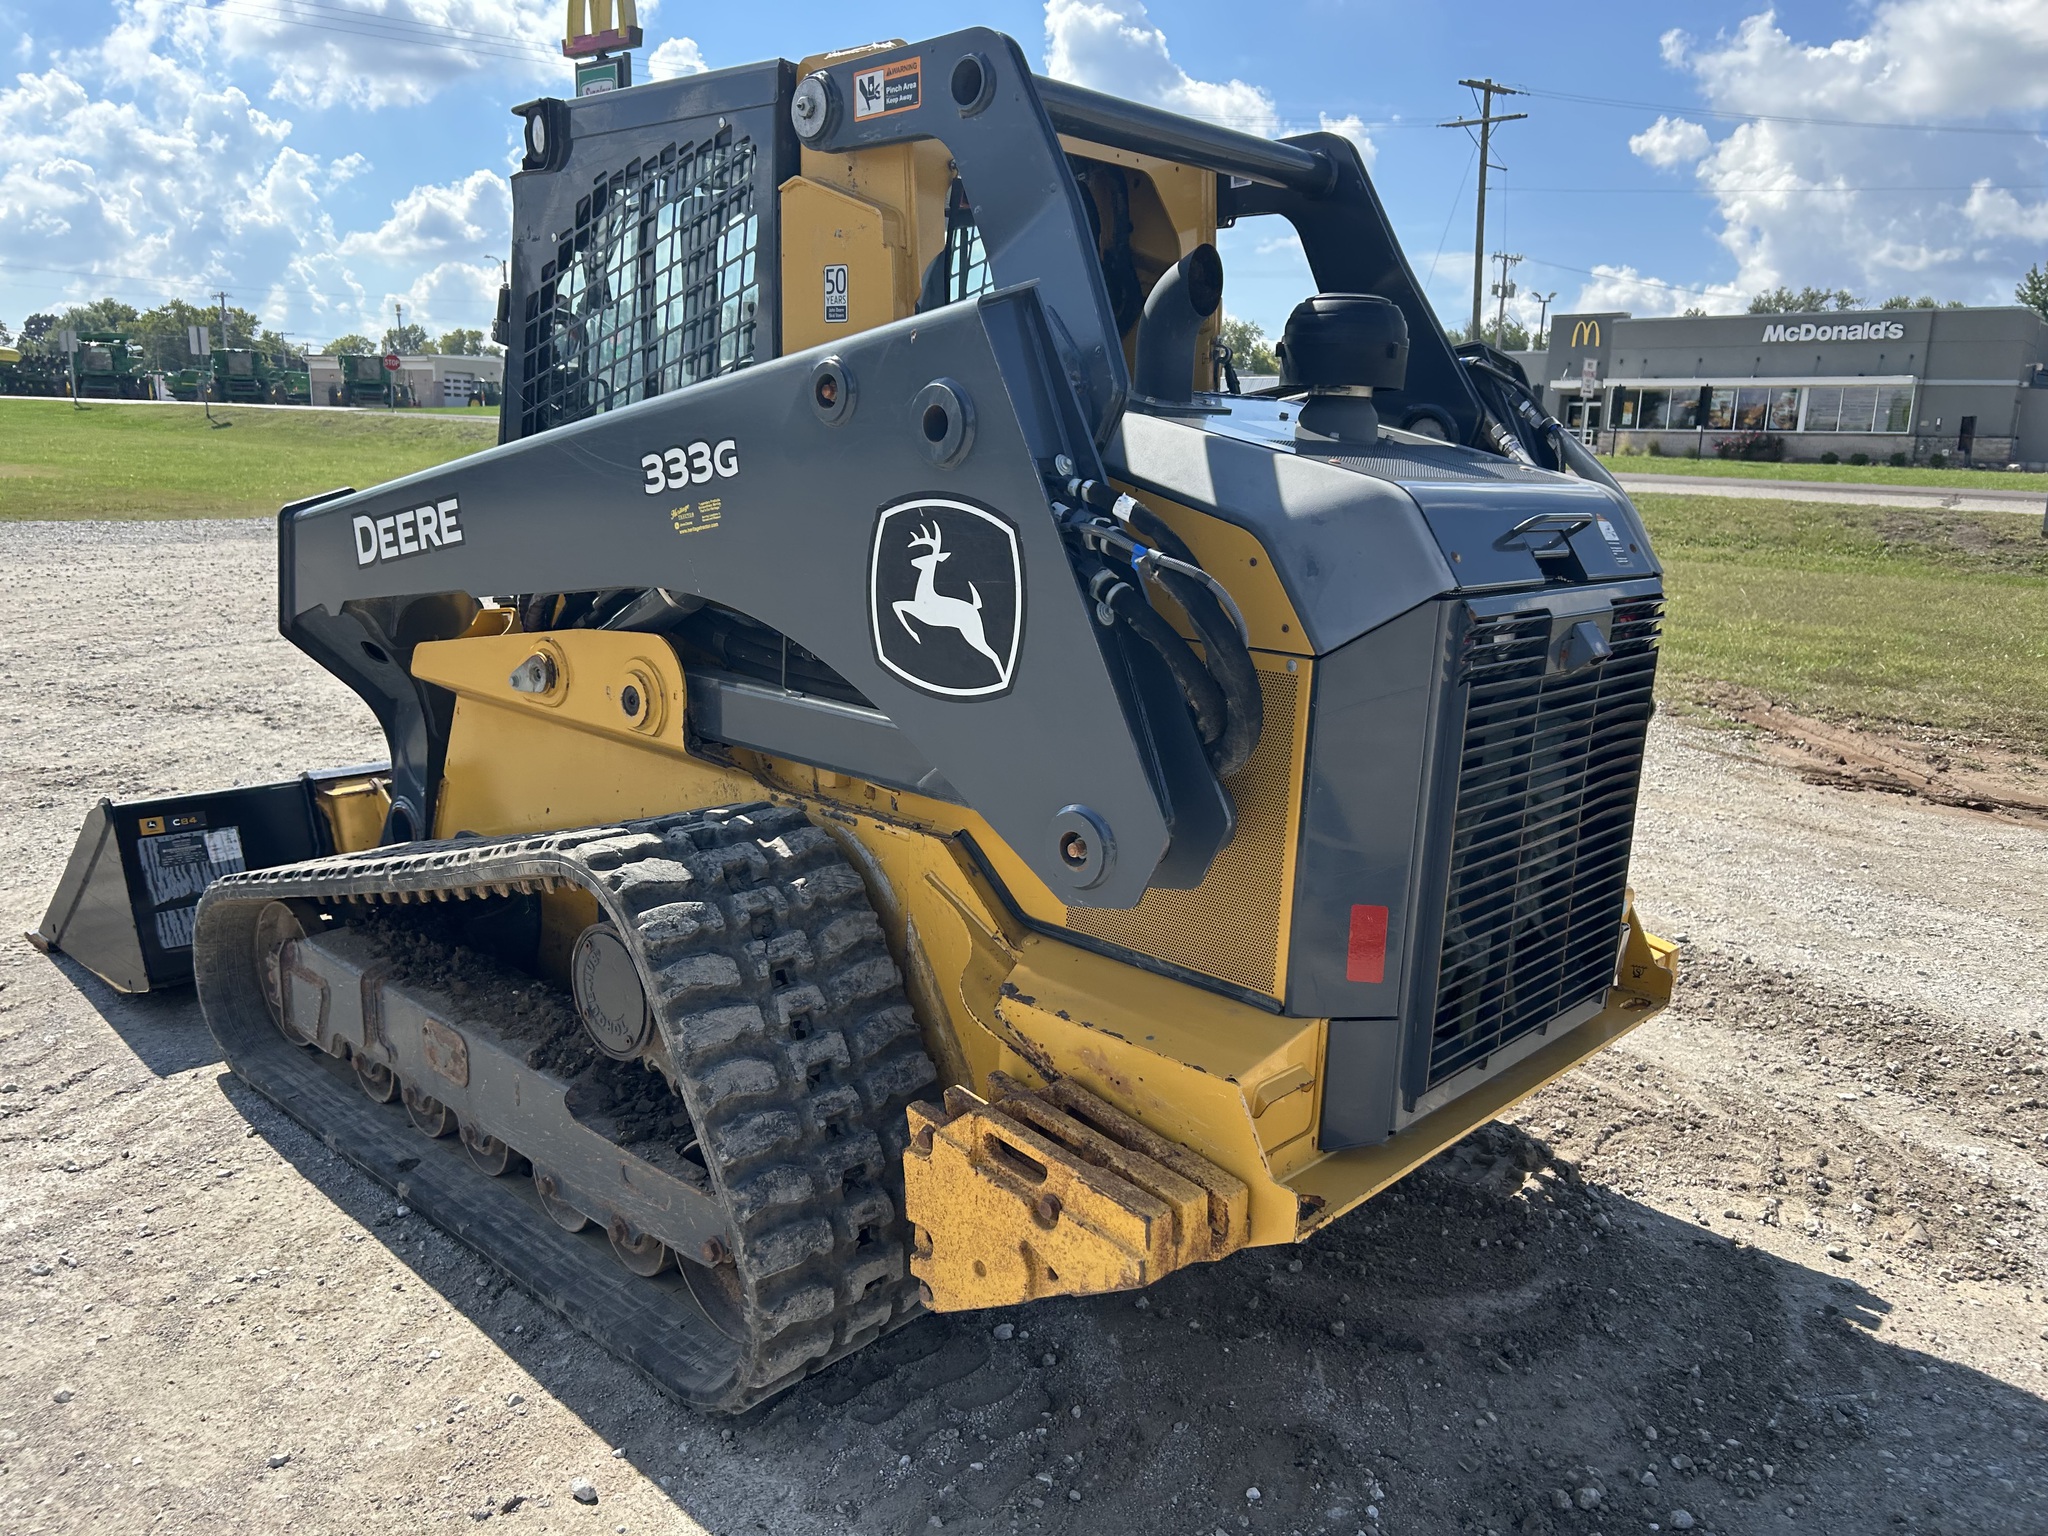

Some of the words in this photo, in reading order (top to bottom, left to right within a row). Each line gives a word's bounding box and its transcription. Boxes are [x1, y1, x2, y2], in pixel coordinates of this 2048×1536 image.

[891, 62, 917, 73] WARNING
[886, 85, 902, 94] Pinch
[903, 82, 916, 90] Area
[826, 267, 847, 295] 50
[826, 295, 847, 305] YEARS
[1762, 320, 1904, 343] McDonald's
[641, 439, 739, 494] 333G
[352, 498, 463, 565] DEERE
